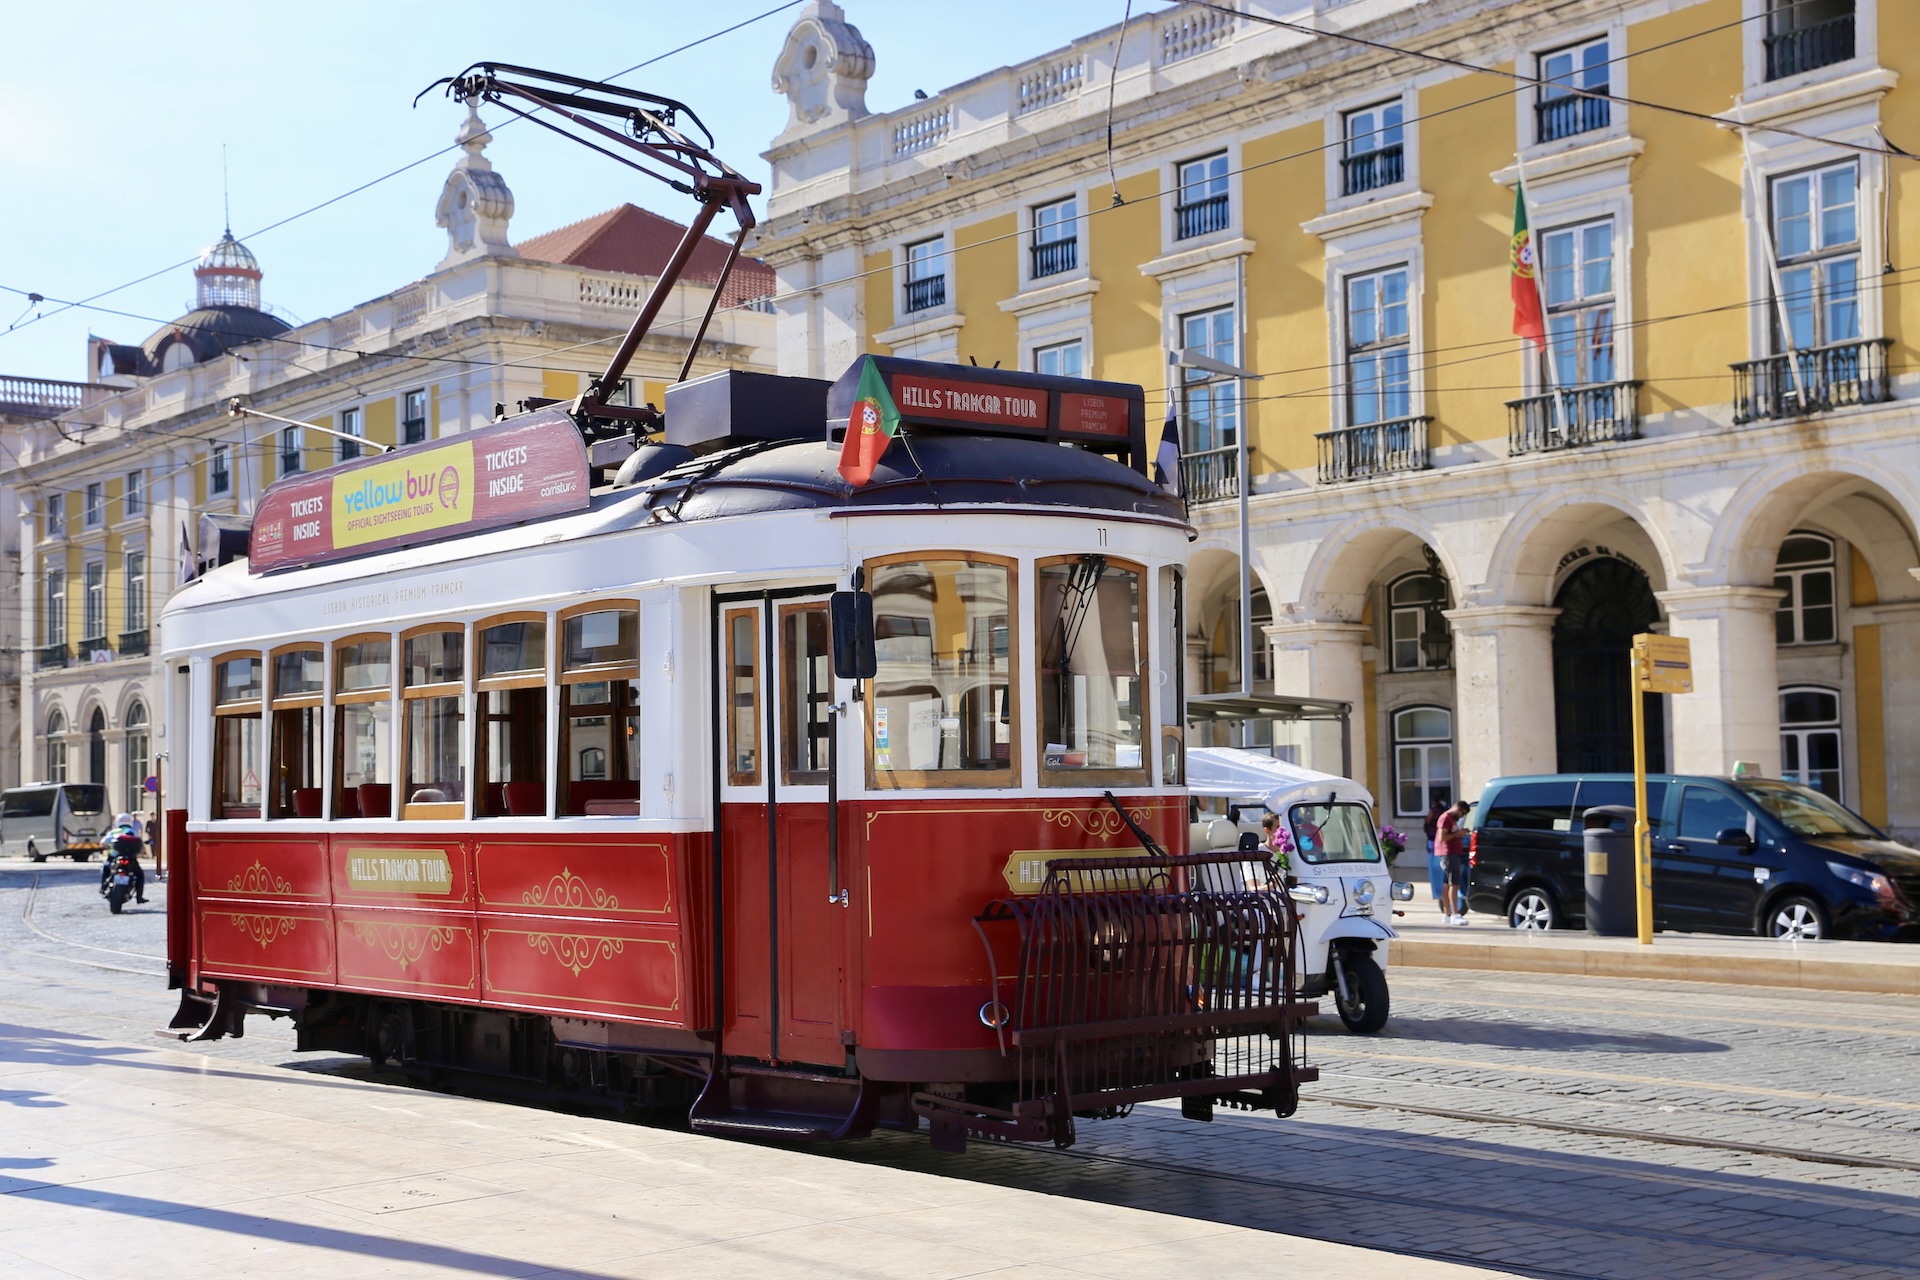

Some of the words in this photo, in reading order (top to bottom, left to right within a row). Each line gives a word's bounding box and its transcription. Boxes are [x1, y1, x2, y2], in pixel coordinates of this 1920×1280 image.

[902, 386, 942, 409] HILLS
[945, 390, 1001, 415] TRAMCAR
[1003, 396, 1037, 418] TOUR
[1083, 397, 1104, 408] LISBON
[1080, 408, 1107, 420] PREMIUM
[1081, 420, 1107, 431] TRAMCAR
[486, 445, 527, 472] TICKETS
[344, 477, 403, 515] yellow
[406, 468, 436, 500] bus
[489, 473, 524, 498] INSIDE
[540, 481, 571, 497] carristur
[290, 496, 323, 518] TICKETS
[347, 516, 373, 531] OFFICIAL
[373, 507, 412, 527] SIGHTSEEING
[412, 502, 434, 520] TOURS
[293, 525, 321, 541] INSIDE
[1097, 528, 1107, 546] 11
[323, 602, 347, 615] LISBON
[351, 594, 390, 610] HISTORICAL
[395, 586, 426, 601] PREMIUM
[431, 581, 464, 595] TRAMCAR
[1047, 757, 1061, 767] Col.
[351, 858, 379, 880] HILLS
[379, 858, 420, 881] TRAMCAR
[420, 859, 447, 882] TOUR
